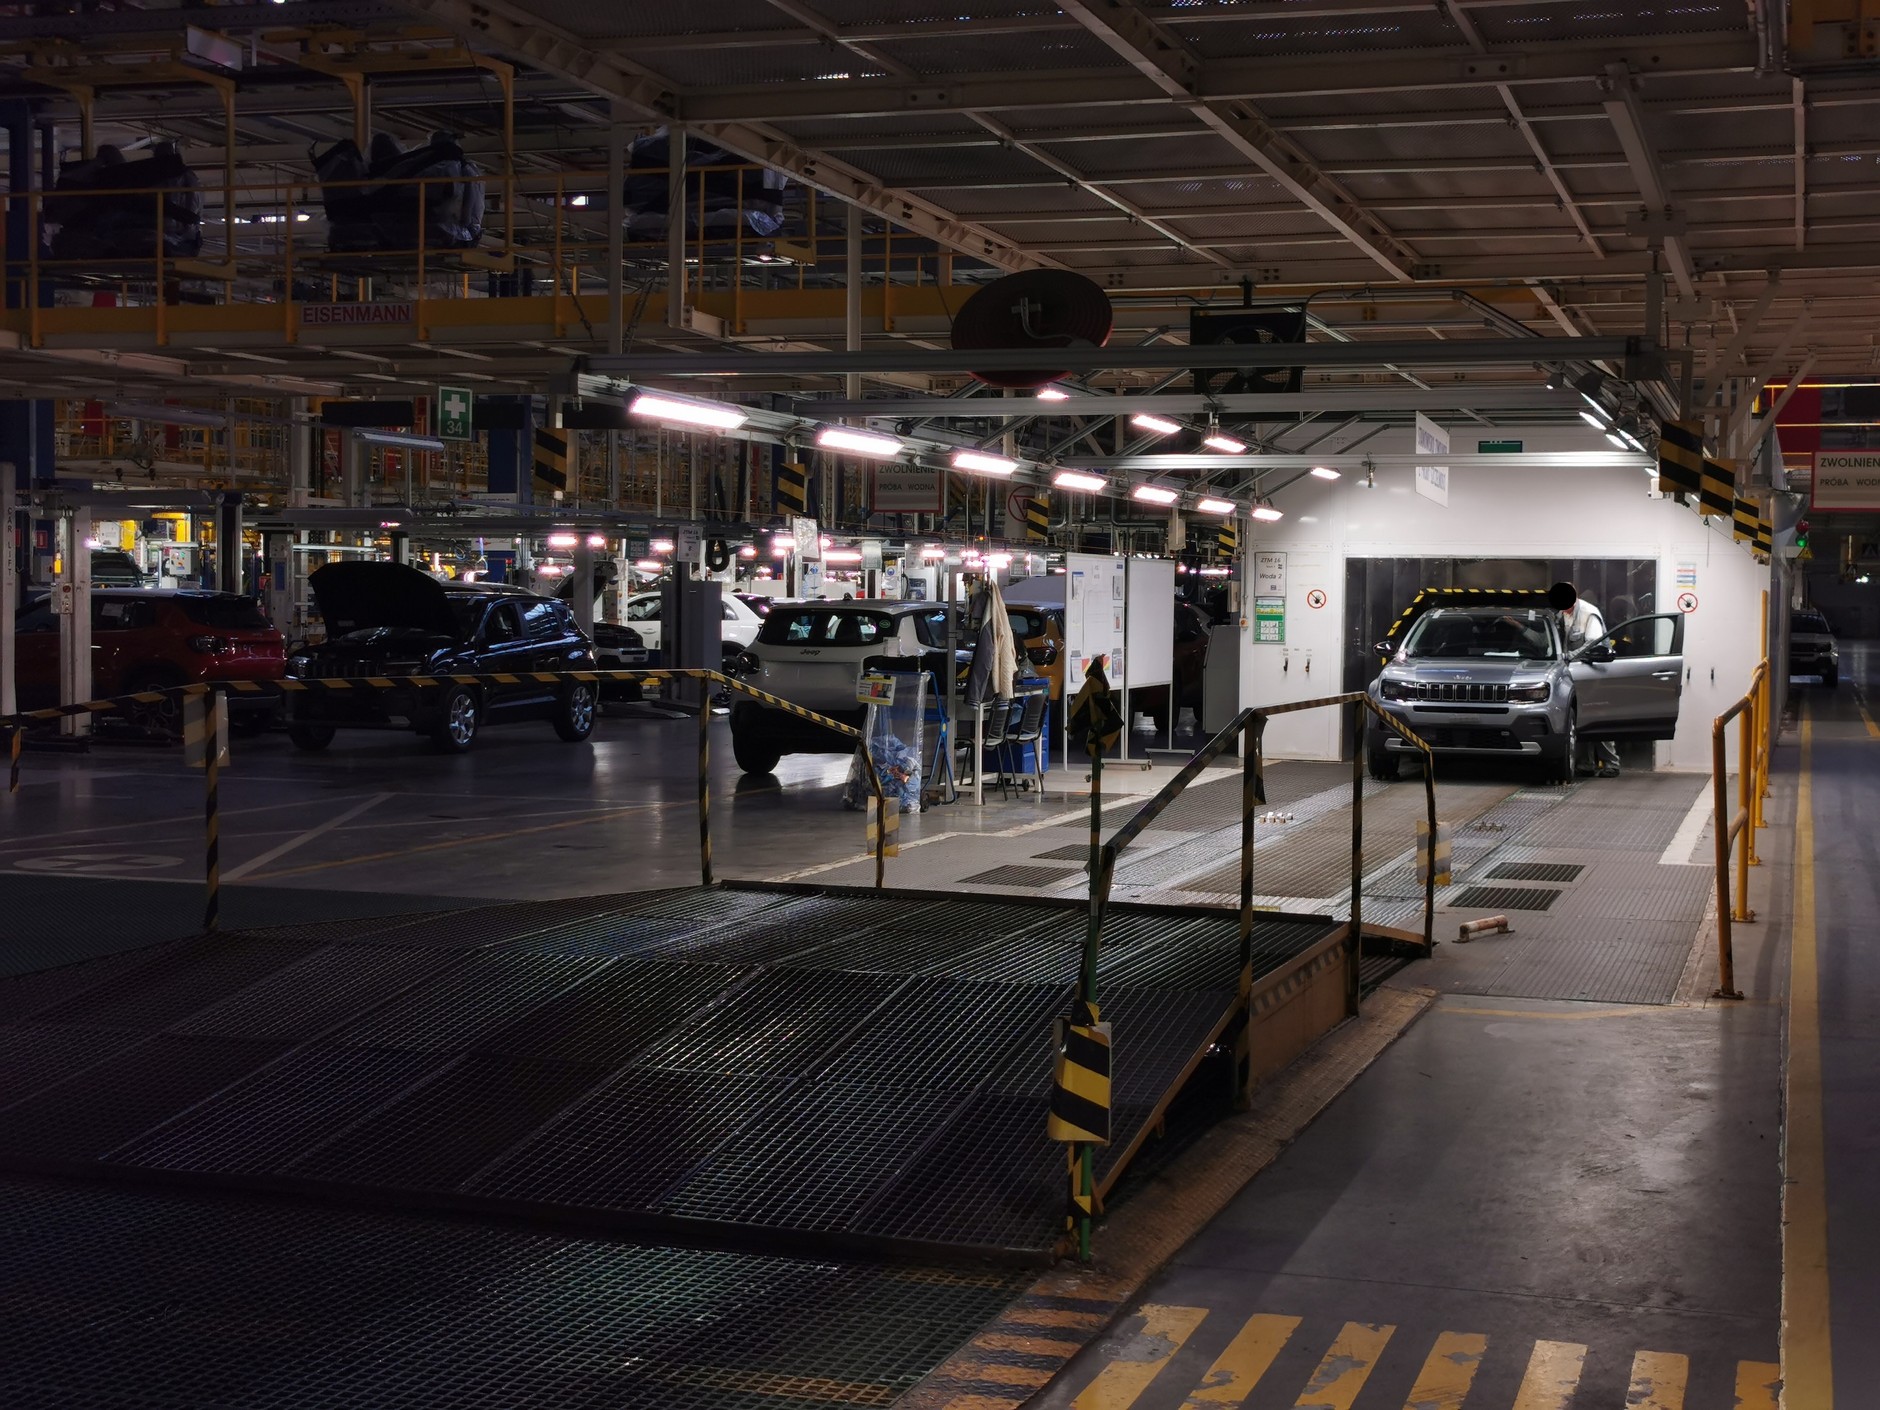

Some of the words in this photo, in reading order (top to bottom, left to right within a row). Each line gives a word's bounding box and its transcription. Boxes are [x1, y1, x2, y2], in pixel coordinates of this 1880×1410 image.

[303, 305, 410, 323] EISENMANN
[447, 420, 463, 434] 34
[879, 464, 936, 474] ZWOLNIENIE
[907, 483, 936, 491] WODNA
